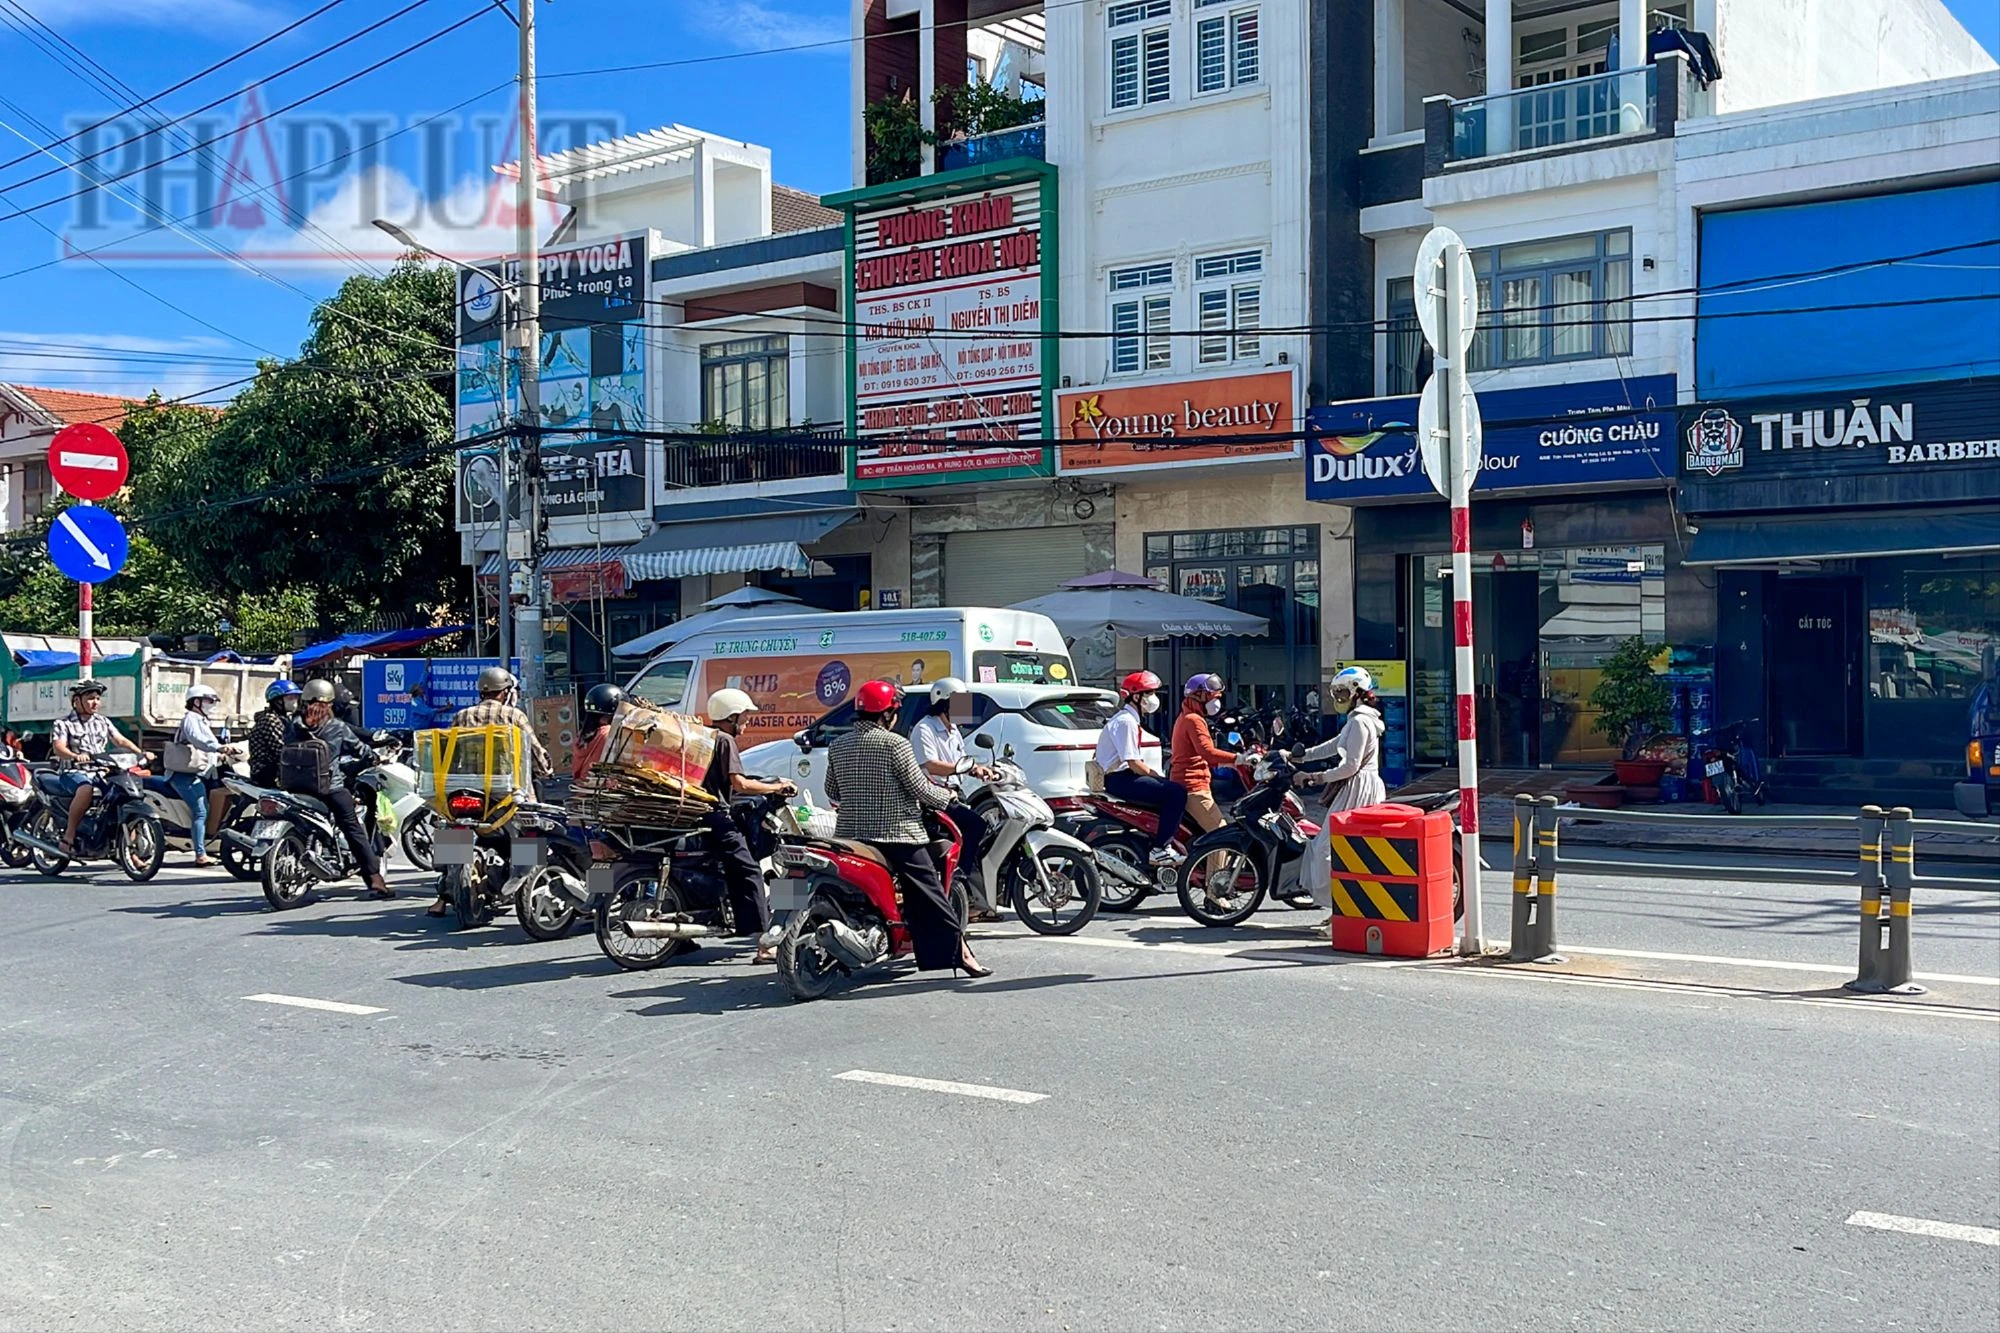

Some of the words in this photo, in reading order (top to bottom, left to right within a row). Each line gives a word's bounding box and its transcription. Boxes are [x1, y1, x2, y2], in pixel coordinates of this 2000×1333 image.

[879, 207, 946, 249] PHÒNG
[951, 193, 1013, 235] KHÁM
[579, 241, 632, 278] YOGA
[857, 247, 935, 291] CHUYÊN
[940, 240, 996, 278] KHOA
[1000, 227, 1037, 272] NỘI
[618, 275, 633, 289] ta
[997, 286, 1010, 297] BS
[893, 302, 905, 312] BS
[907, 300, 921, 311] CK
[951, 302, 991, 331] NGUYỄN
[994, 304, 1010, 327] THỊ
[975, 368, 997, 379] 0949
[999, 366, 1016, 376] 256
[1018, 363, 1035, 373] 715
[881, 379, 902, 390] 0919
[903, 376, 920, 387] 630
[921, 375, 937, 385] 375
[1183, 399, 1281, 431] beauty
[1752, 399, 1914, 450] THUẬN
[1540, 425, 1604, 447] CƯỜNG
[1608, 421, 1660, 442] CHÂU
[595, 448, 634, 478] TEA
[1313, 453, 1404, 483] Dulux
[1688, 451, 1740, 468] BARBERMAN
[1798, 615, 1814, 629] CẮT
[1817, 616, 1832, 629] TÓC
[712, 641, 725, 655] XE
[728, 639, 759, 654] TRUNG
[743, 673, 778, 693] SHB
[823, 679, 846, 697] 8%
[746, 715, 784, 728] MASTER
[787, 714, 817, 727] CARD
